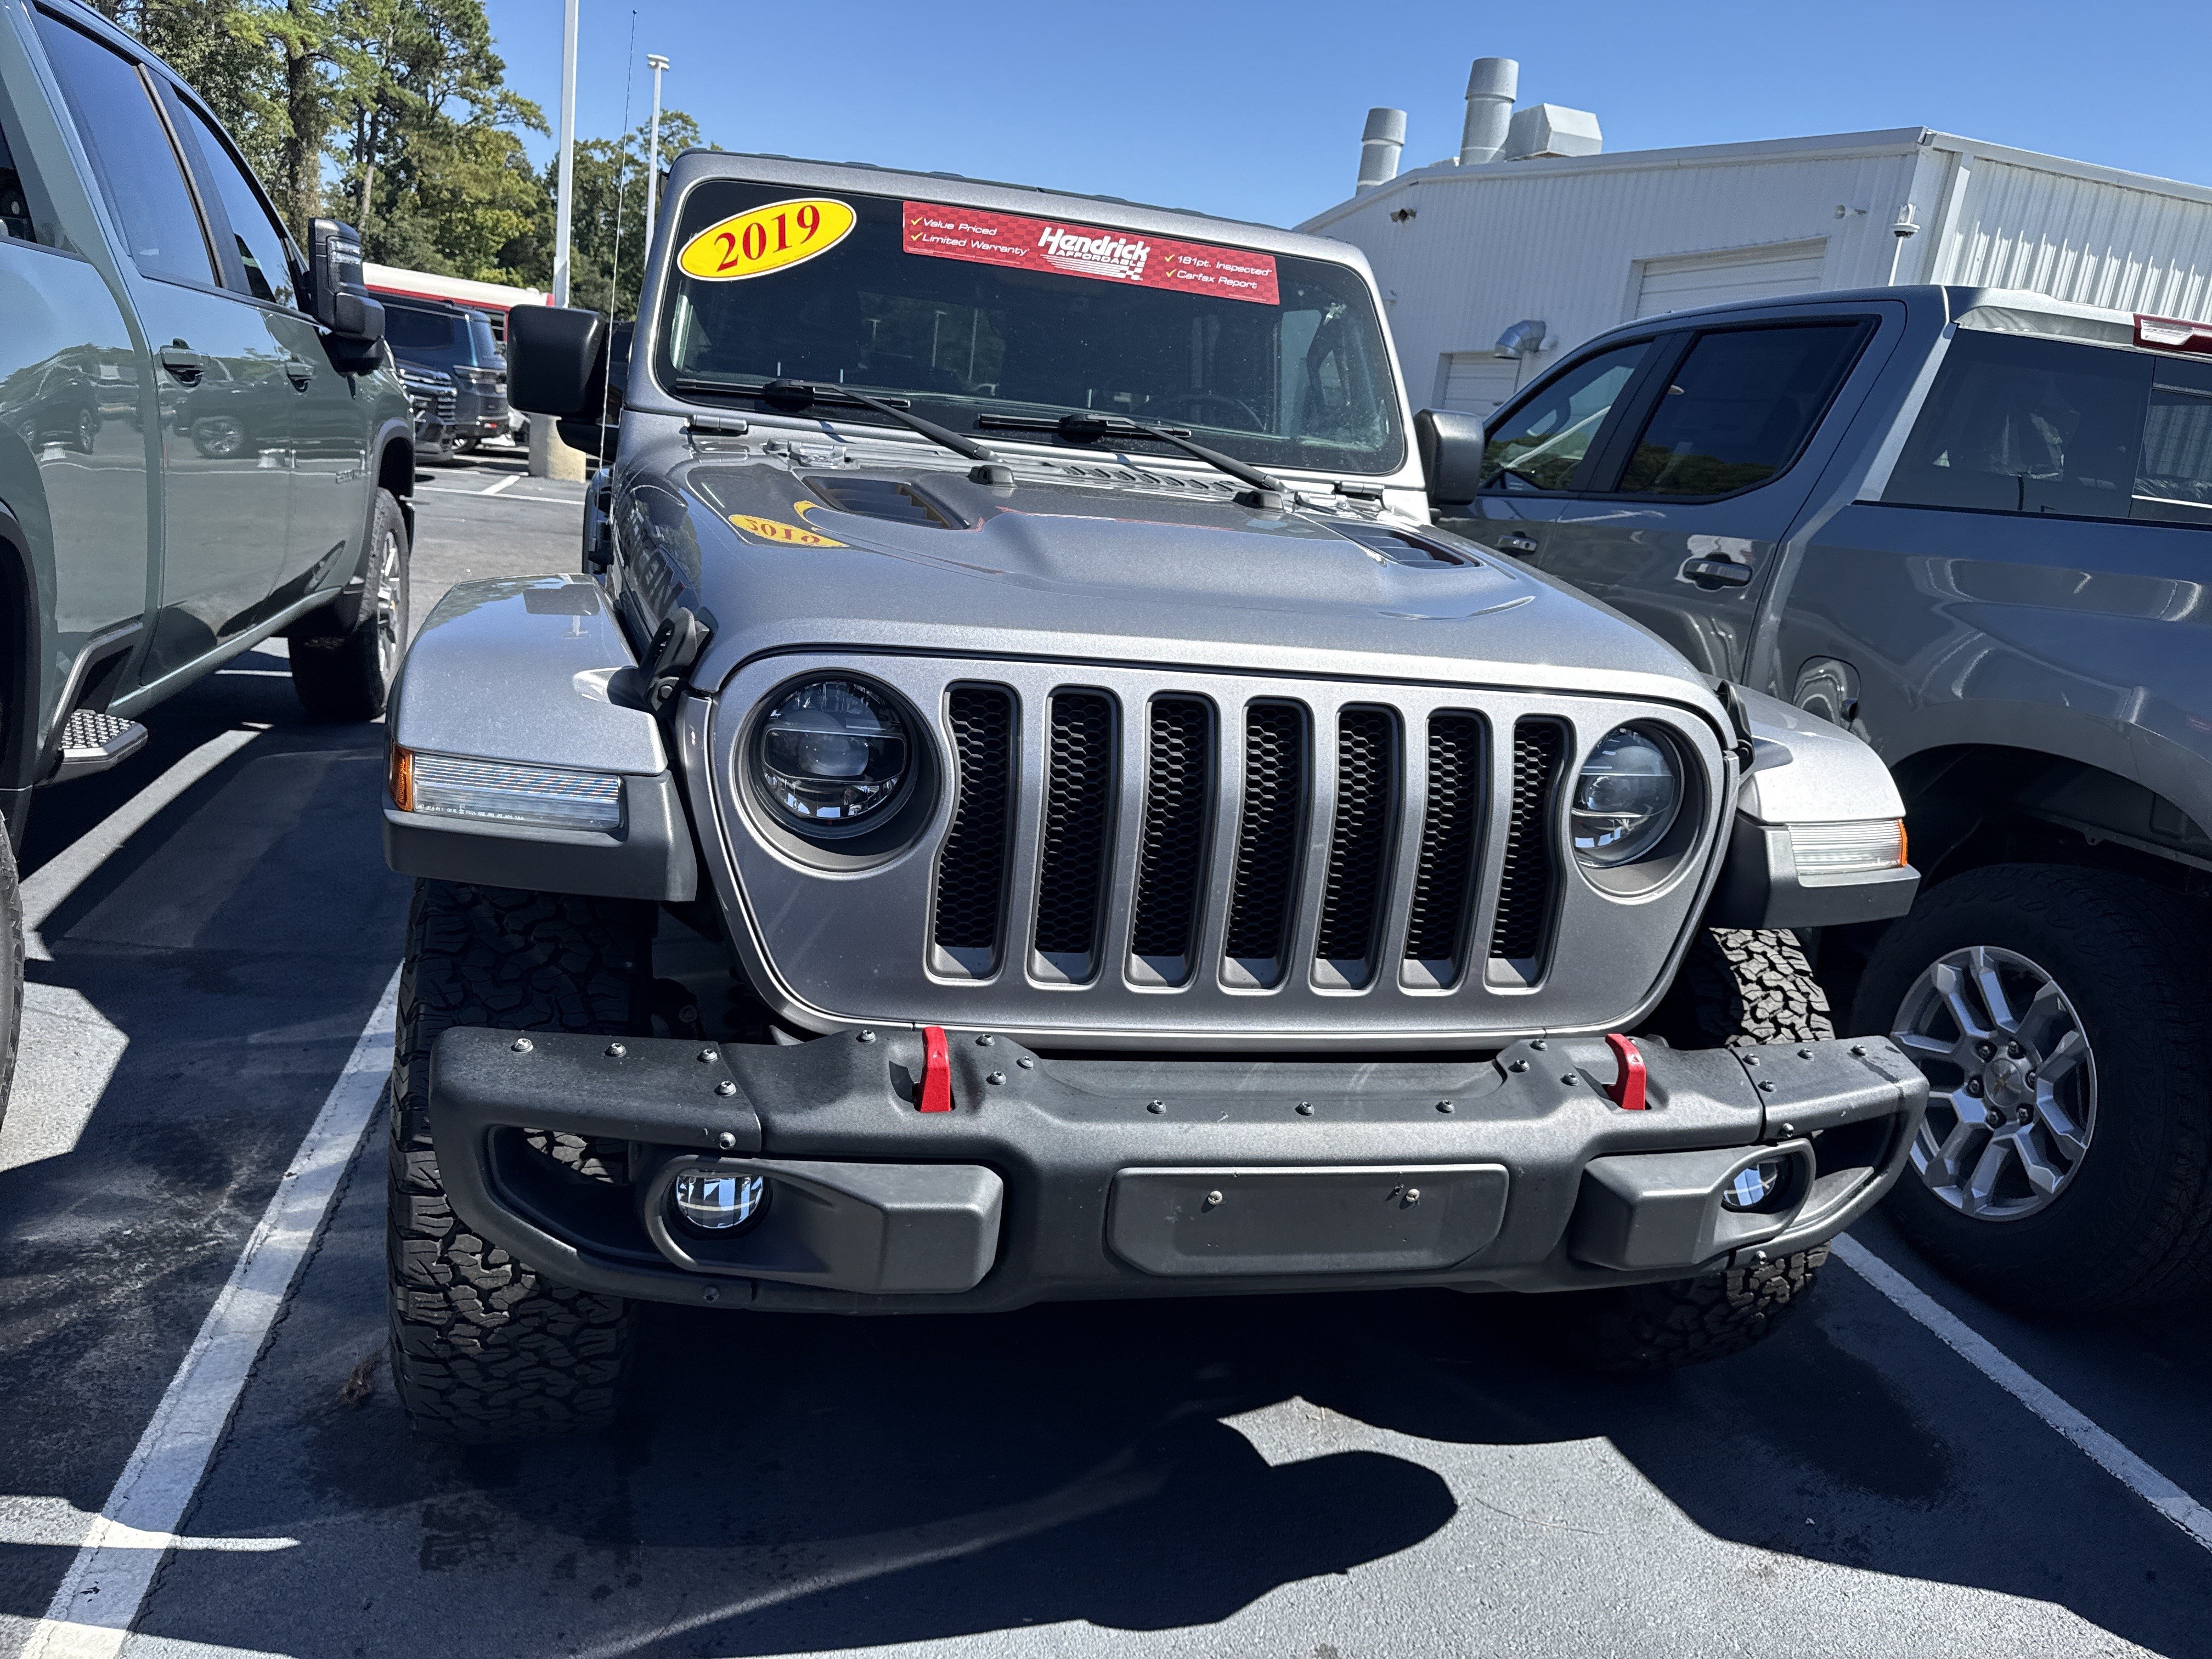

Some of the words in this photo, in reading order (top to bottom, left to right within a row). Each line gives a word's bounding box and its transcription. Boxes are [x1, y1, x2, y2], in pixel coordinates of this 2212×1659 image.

[923, 218, 955, 230] Value
[958, 223, 998, 236] Priced
[714, 205, 820, 272] 2019
[922, 233, 967, 247] Limited
[1037, 227, 1151, 262] Hendrick
[1056, 250, 1146, 268] AFFORDABLE
[1178, 256, 1211, 268] 181pt.
[1177, 270, 1215, 283] Carfax
[1218, 276, 1257, 289] Report
